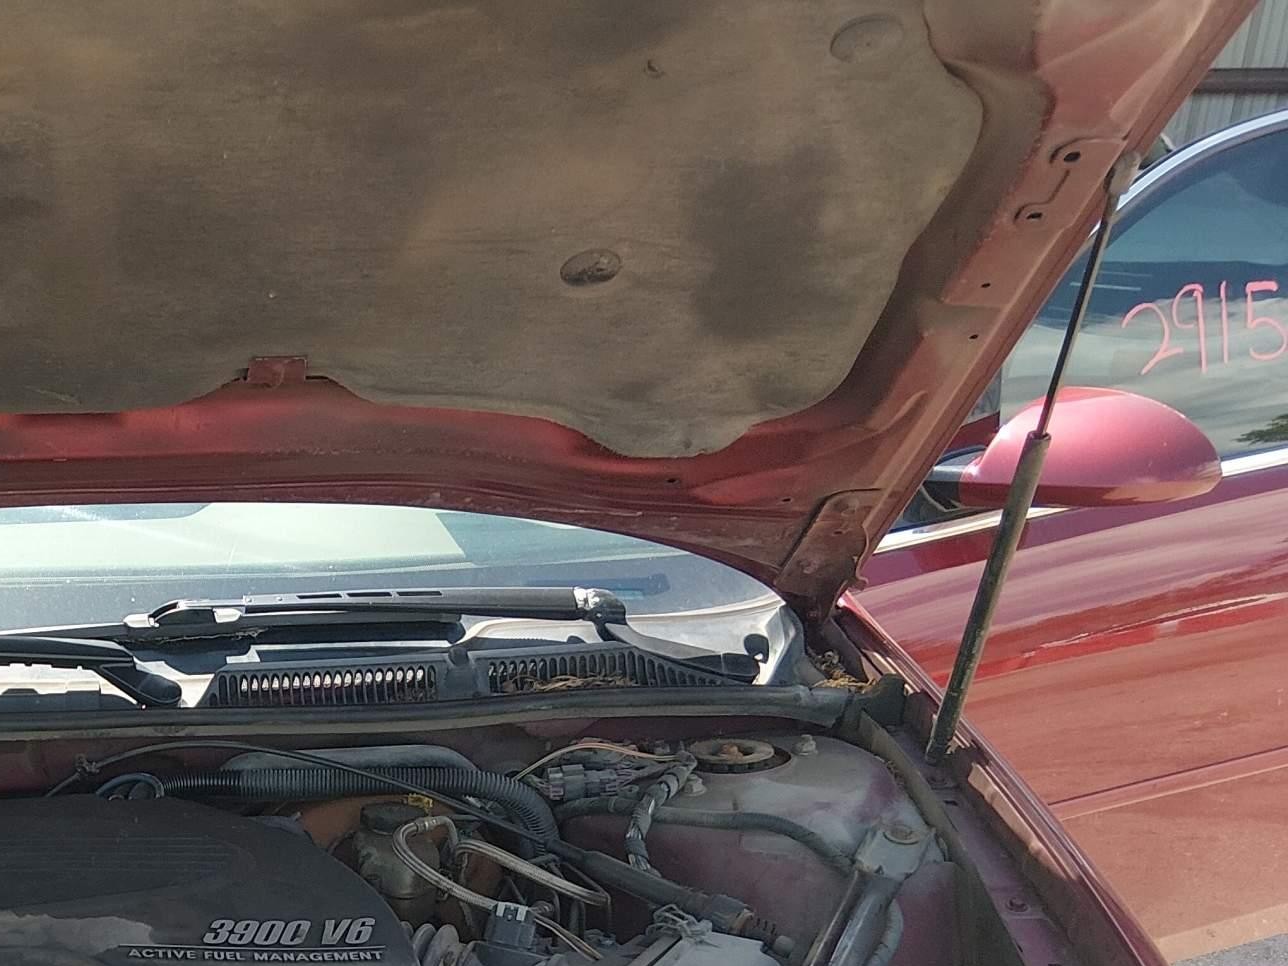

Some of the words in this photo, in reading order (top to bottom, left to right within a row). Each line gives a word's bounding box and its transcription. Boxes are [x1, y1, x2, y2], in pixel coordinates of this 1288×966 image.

[1121, 279, 1288, 376] 2915
[202, 919, 312, 946] 3900
[321, 917, 376, 946] V6
[128, 948, 197, 960] ACTIVE
[204, 950, 245, 961] FUEL
[254, 950, 384, 962] MANAGEMENT
